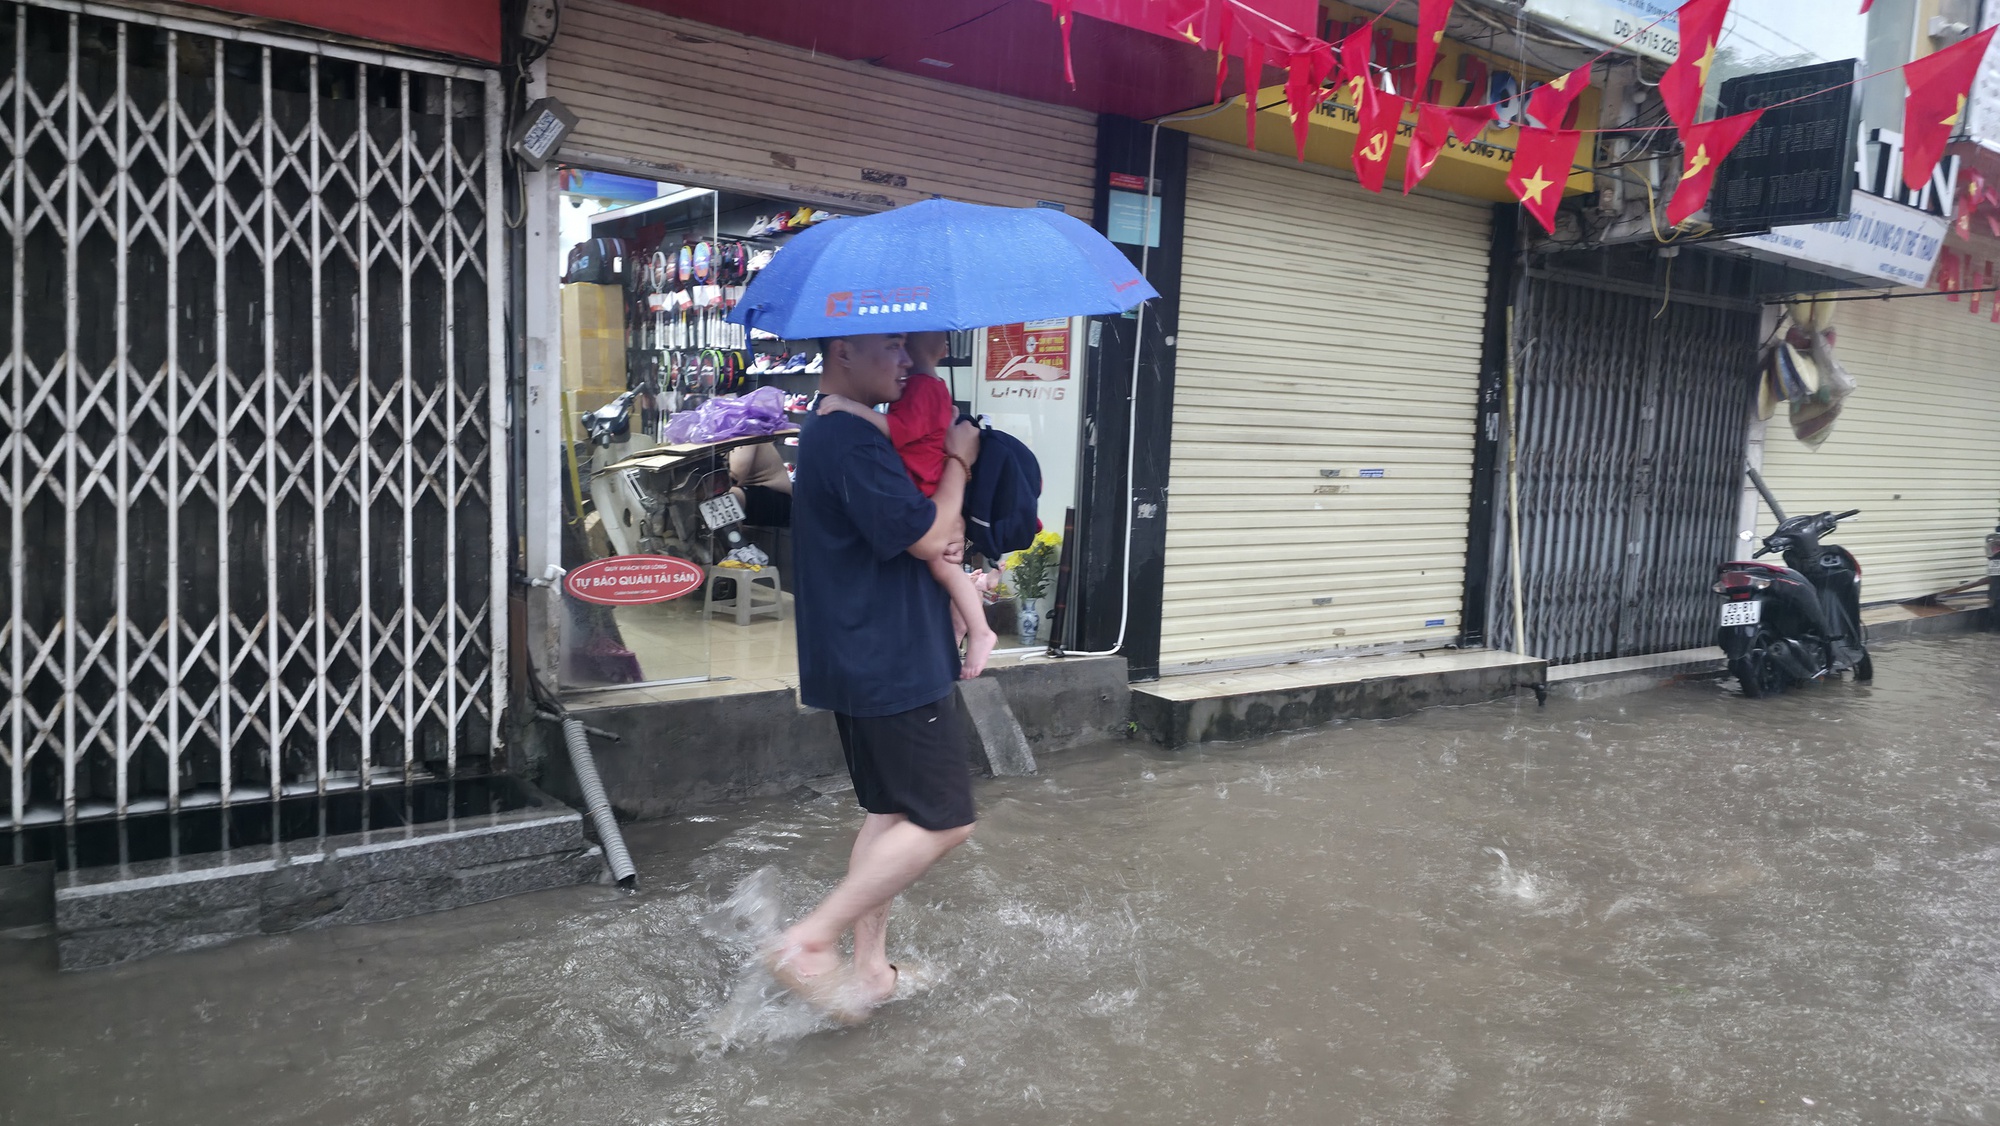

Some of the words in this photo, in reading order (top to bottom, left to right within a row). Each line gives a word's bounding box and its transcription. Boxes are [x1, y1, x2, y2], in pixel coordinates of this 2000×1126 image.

[858, 301, 929, 315] PHARMA
[991, 387, 1066, 401] LI-NING
[575, 577, 592, 590] TỰ
[593, 574, 618, 587] BẢO
[618, 573, 653, 586] QUẢN
[672, 571, 695, 583] SẢN
